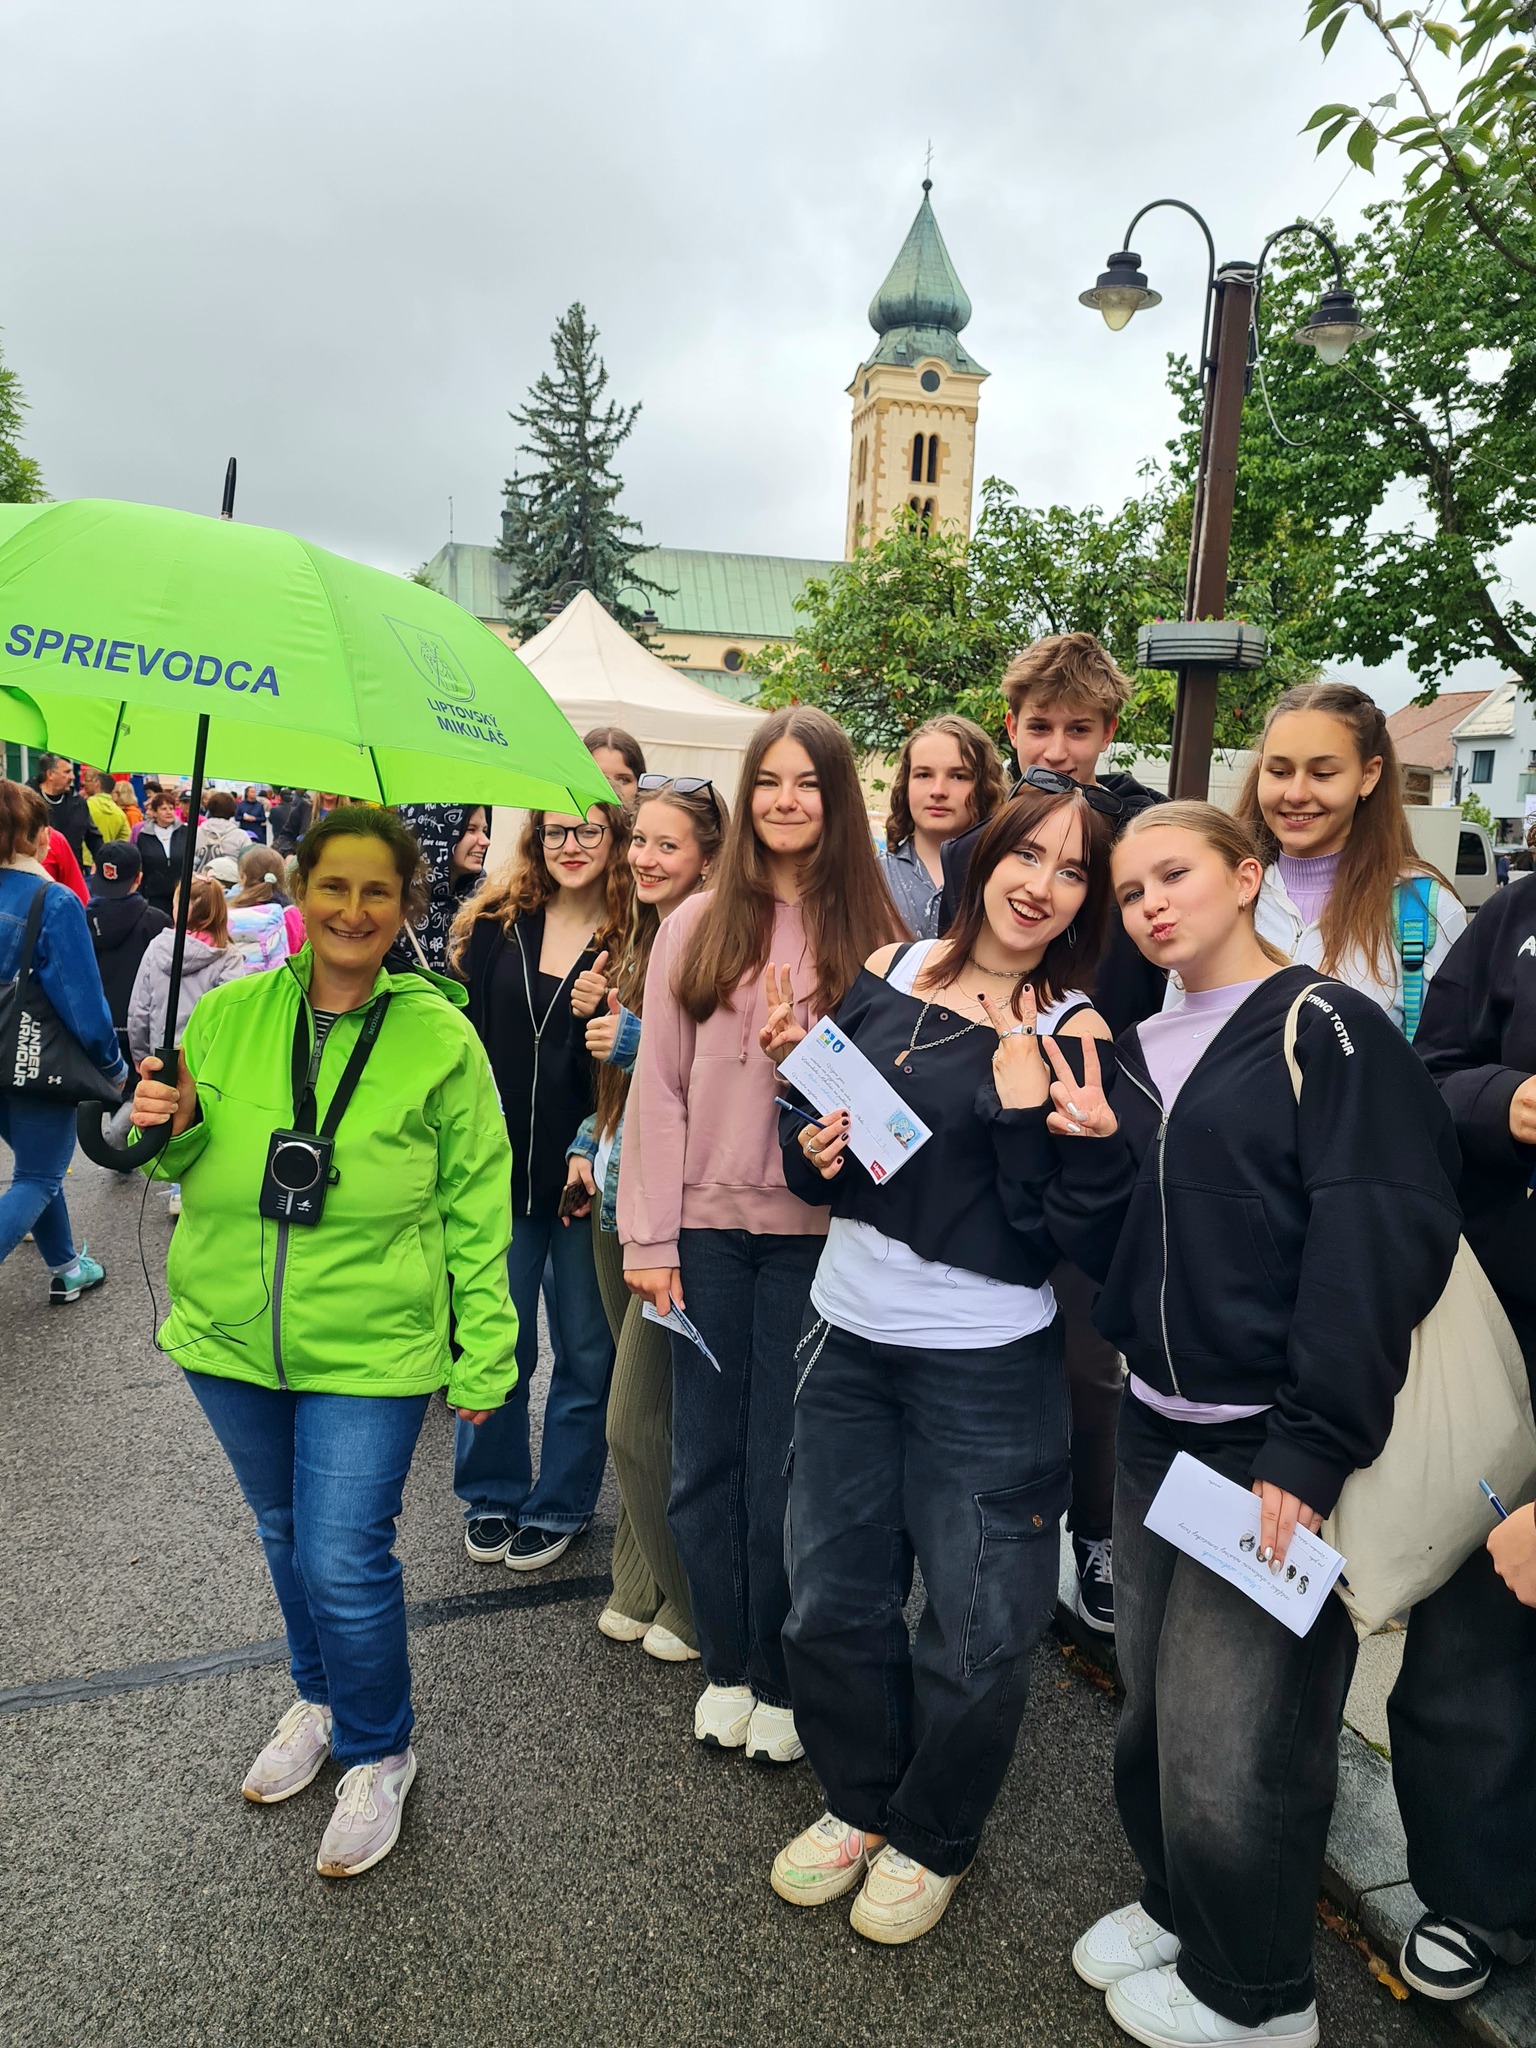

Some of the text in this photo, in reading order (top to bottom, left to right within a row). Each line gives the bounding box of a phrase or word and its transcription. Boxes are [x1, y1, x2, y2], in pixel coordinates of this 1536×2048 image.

[5, 624, 280, 697] SPRIEVODCA
[427, 698, 498, 728] LIPTOVSKÝ
[436, 715, 509, 747] MIKULÁŠ
[368, 1003, 382, 1035] MONAC
[1304, 993, 1355, 1057] TRNG TGTHR
[13, 1011, 32, 1087] ARMOUR
[27, 1021, 41, 1080] UNDER
